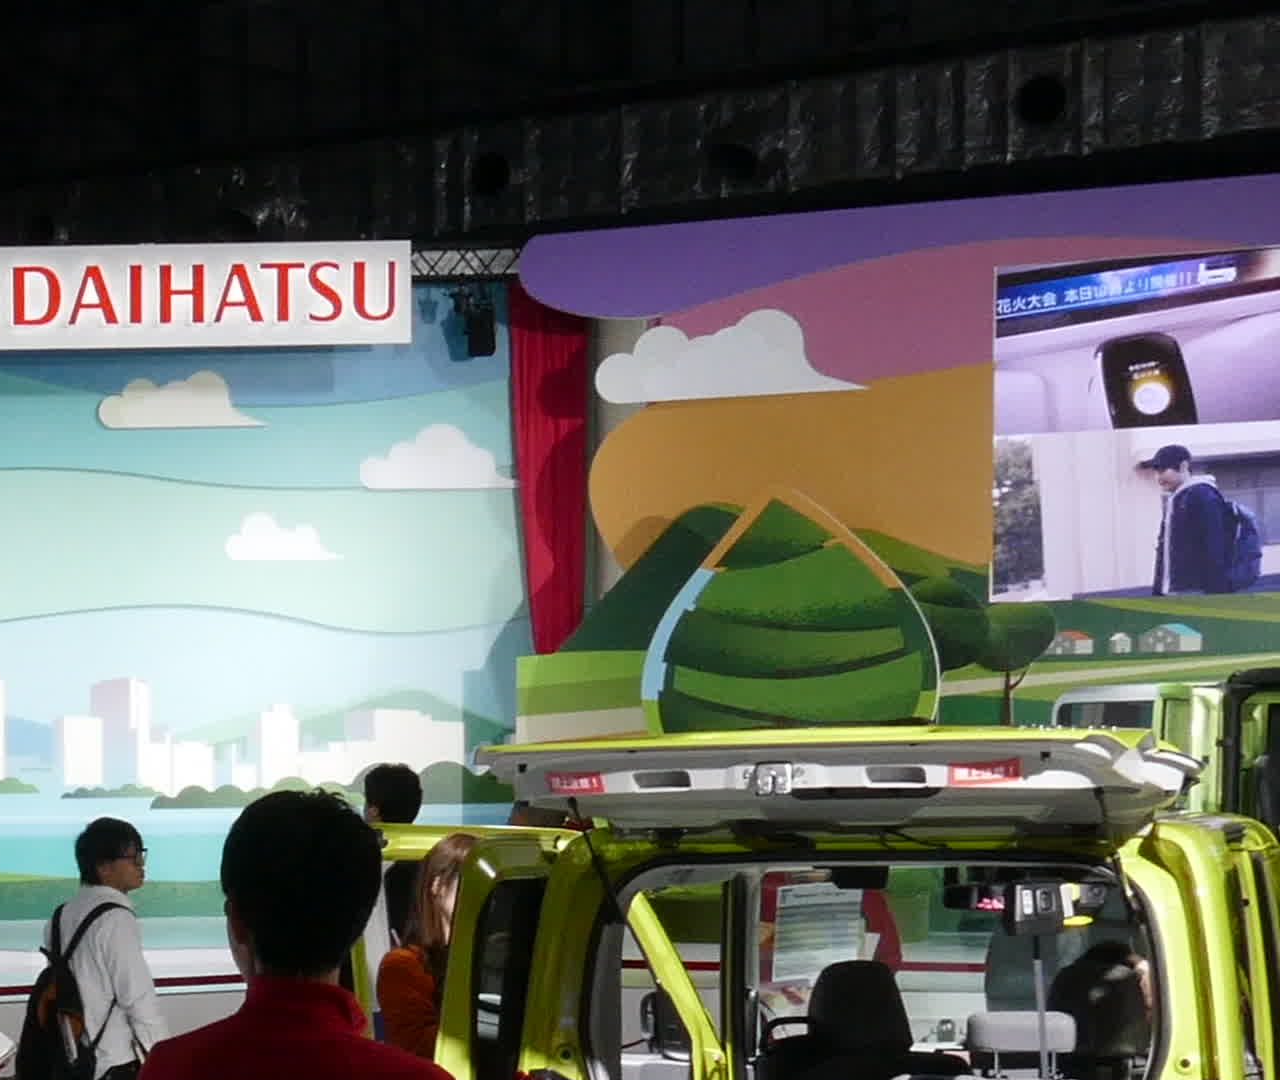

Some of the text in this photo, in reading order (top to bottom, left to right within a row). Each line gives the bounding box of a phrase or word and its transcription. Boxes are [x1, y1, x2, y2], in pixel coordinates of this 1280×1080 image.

[11, 260, 397, 326] DAIHATSU
[996, 291, 1057, 314] 花火大会
